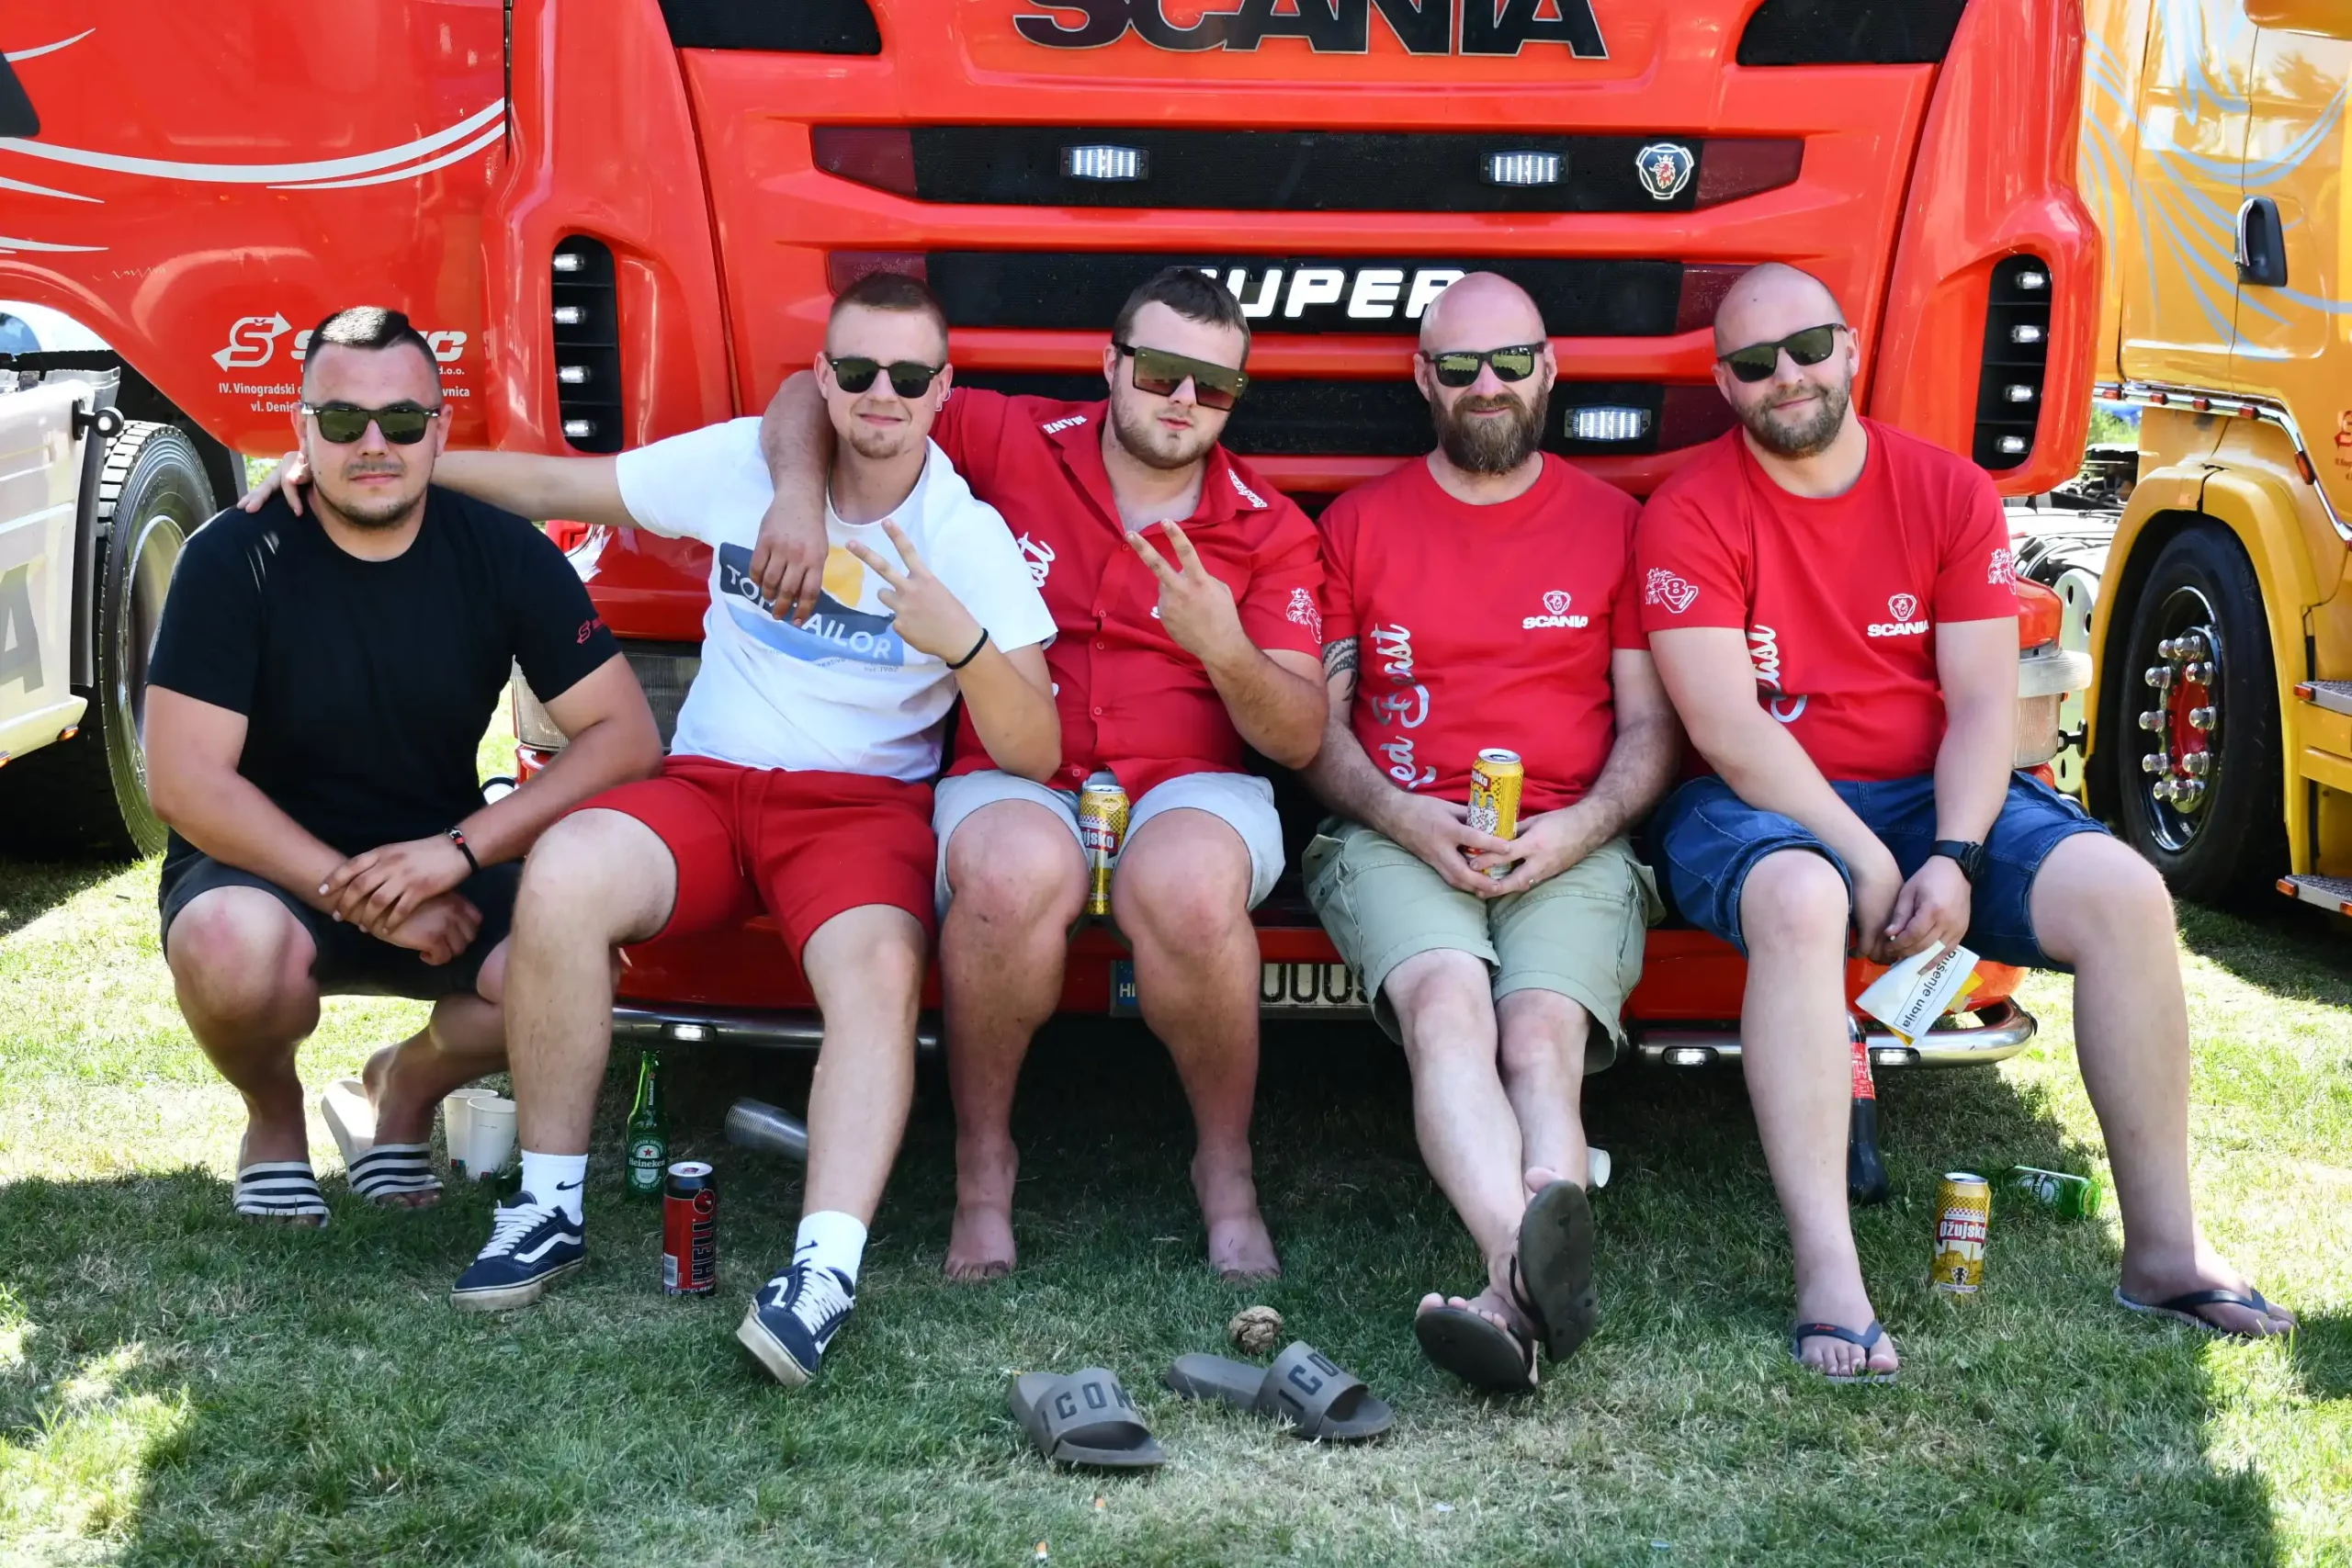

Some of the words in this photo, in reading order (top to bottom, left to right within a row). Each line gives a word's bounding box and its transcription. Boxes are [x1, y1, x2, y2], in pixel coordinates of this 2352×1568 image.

[1200, 268, 1467, 319] UPER
[219, 382, 232, 394] IV.
[233, 381, 295, 398] Vinogradski
[441, 385, 470, 397] vnica
[266, 400, 292, 412] Deni
[1521, 615, 1589, 629] SCANIA
[1867, 619, 1929, 637] SCANIA
[799, 613, 891, 660] AILOR
[1084, 828, 1114, 849] ujsko
[1902, 998, 1926, 1028] ubija
[628, 1156, 666, 1168] Heineken
[1939, 1220, 1985, 1241] Ožujsko
[692, 1217, 715, 1281] HELL
[1278, 1352, 1340, 1411] ICO
